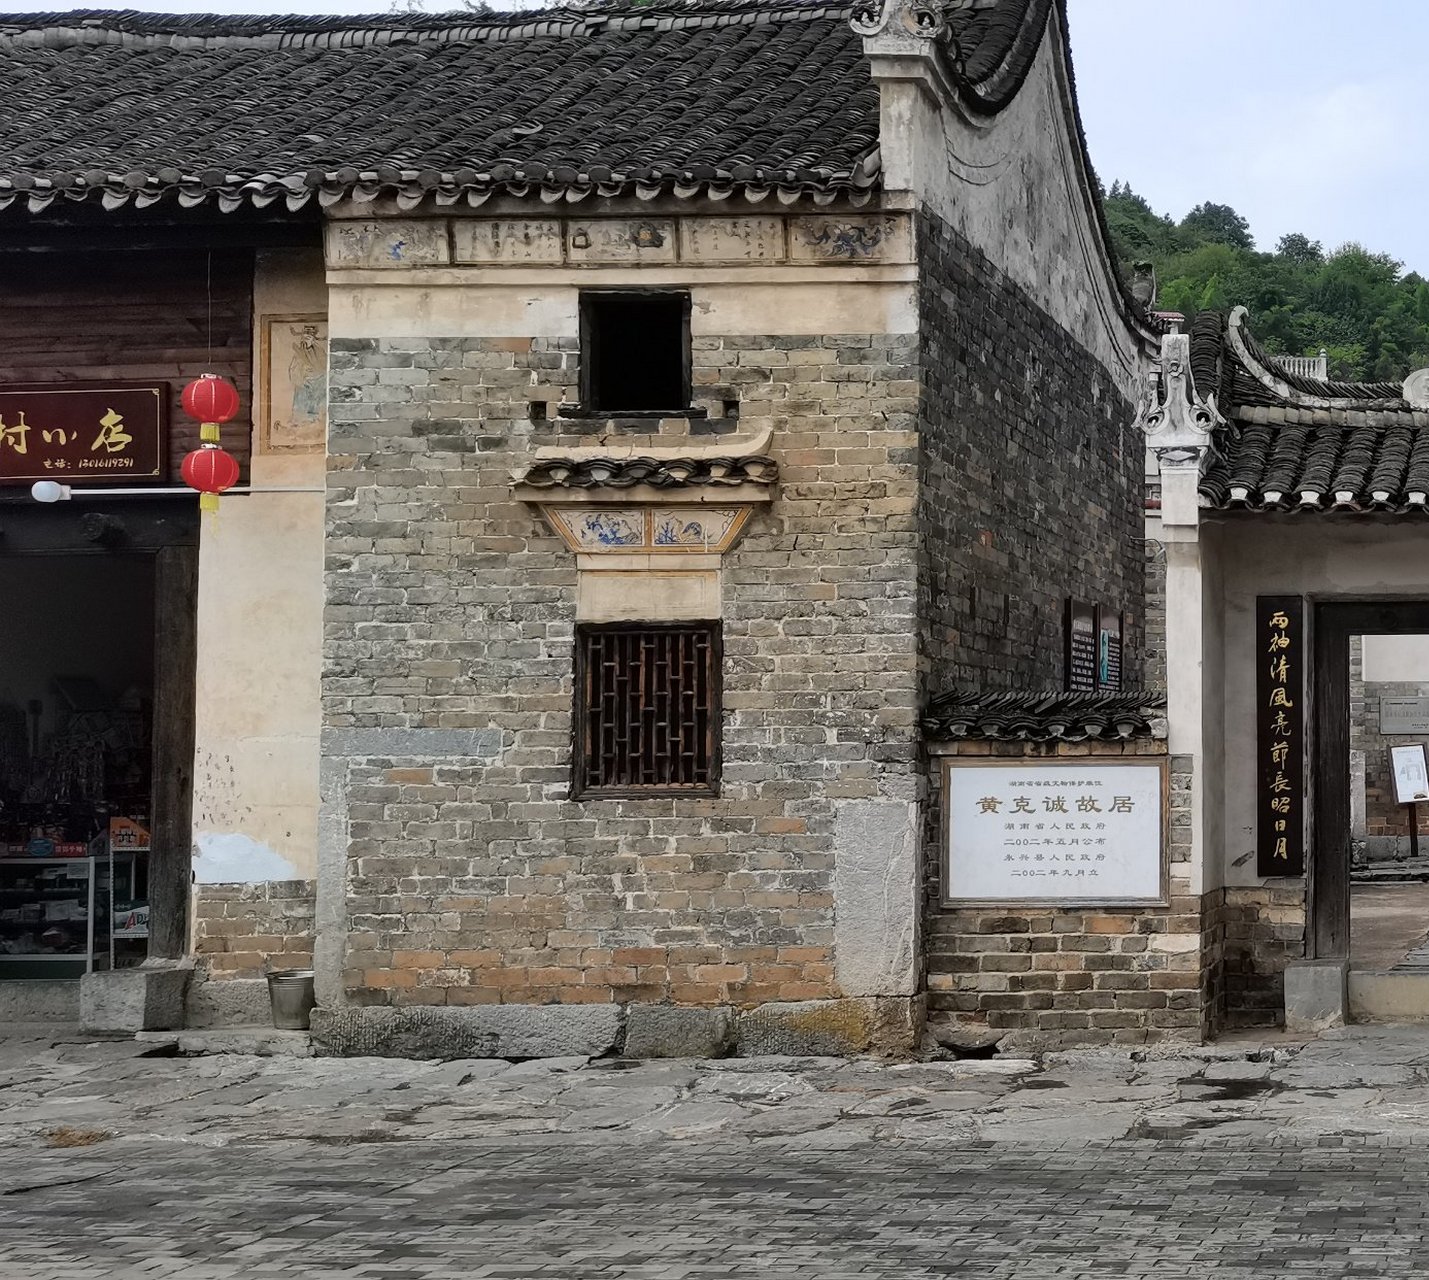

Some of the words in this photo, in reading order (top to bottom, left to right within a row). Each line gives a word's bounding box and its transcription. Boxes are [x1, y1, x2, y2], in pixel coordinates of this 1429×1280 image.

[976, 795, 1136, 815] 黄克诚故居
[1004, 822, 1106, 831] 湖南省人民政府
[1003, 853, 1106, 862] 永兴县人民政府
